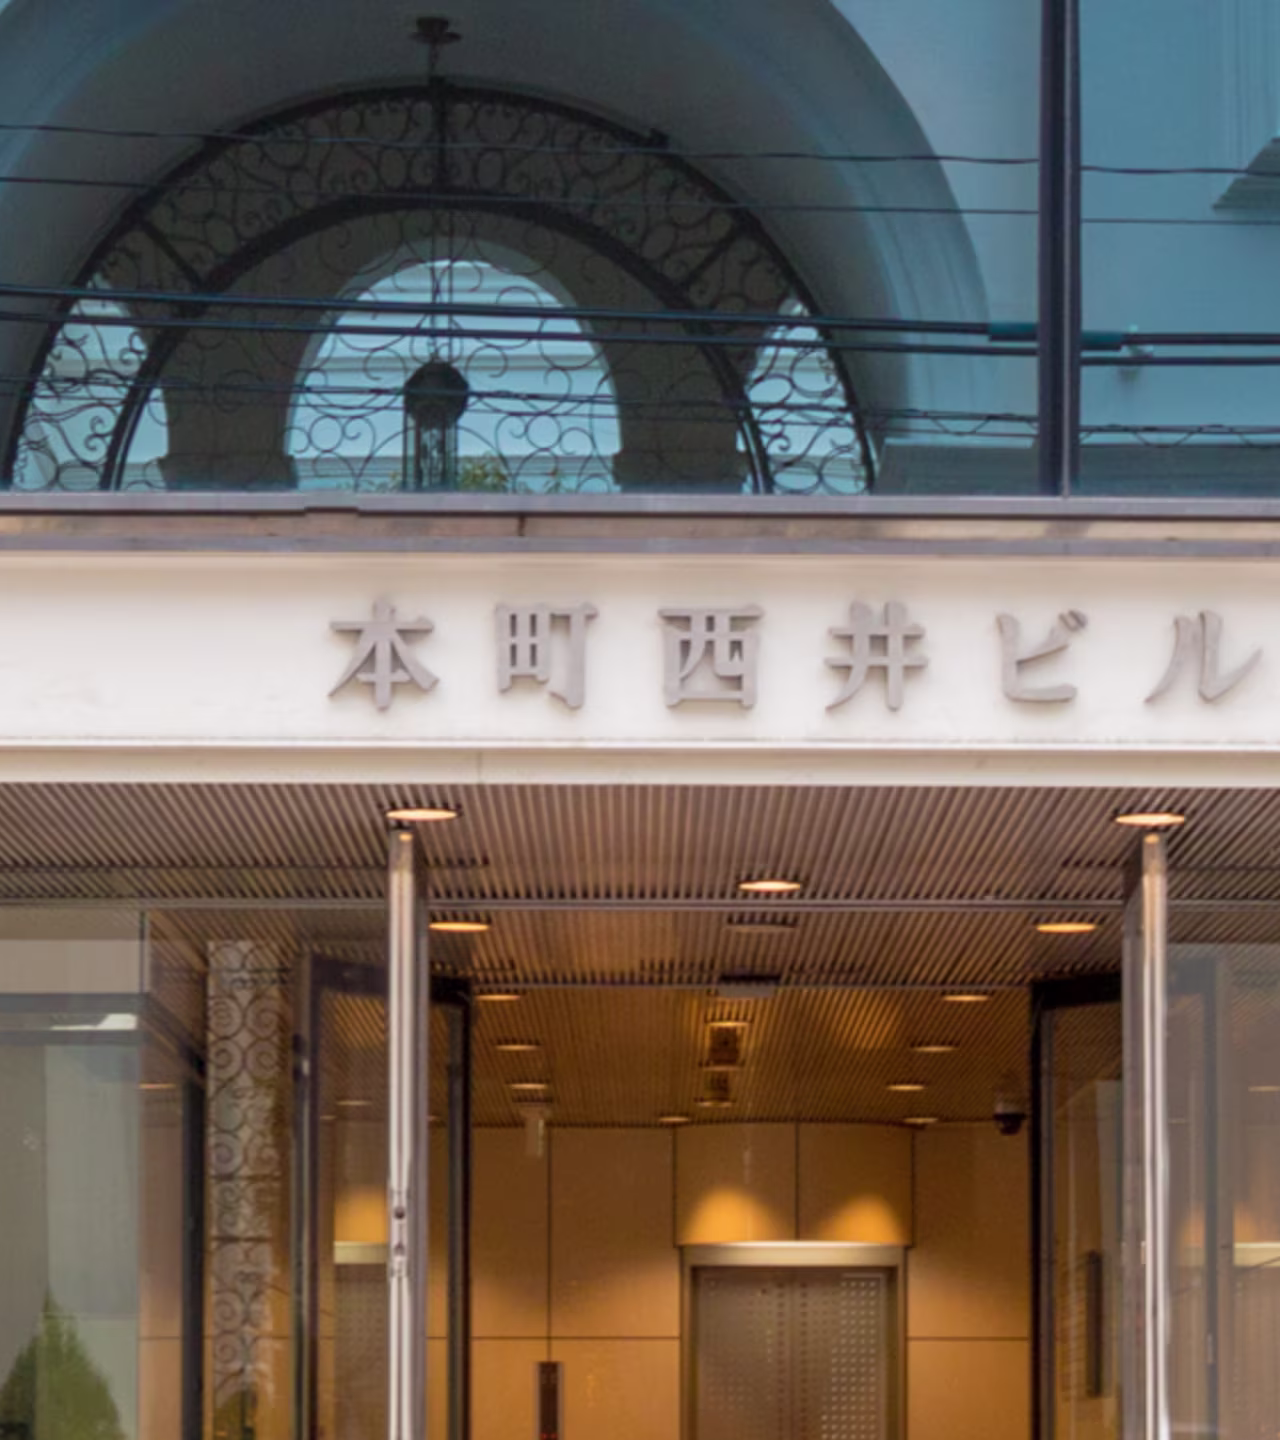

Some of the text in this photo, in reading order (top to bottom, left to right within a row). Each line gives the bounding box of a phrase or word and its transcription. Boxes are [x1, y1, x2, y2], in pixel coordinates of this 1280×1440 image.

[326, 598, 1265, 711] 本町西井ビル
